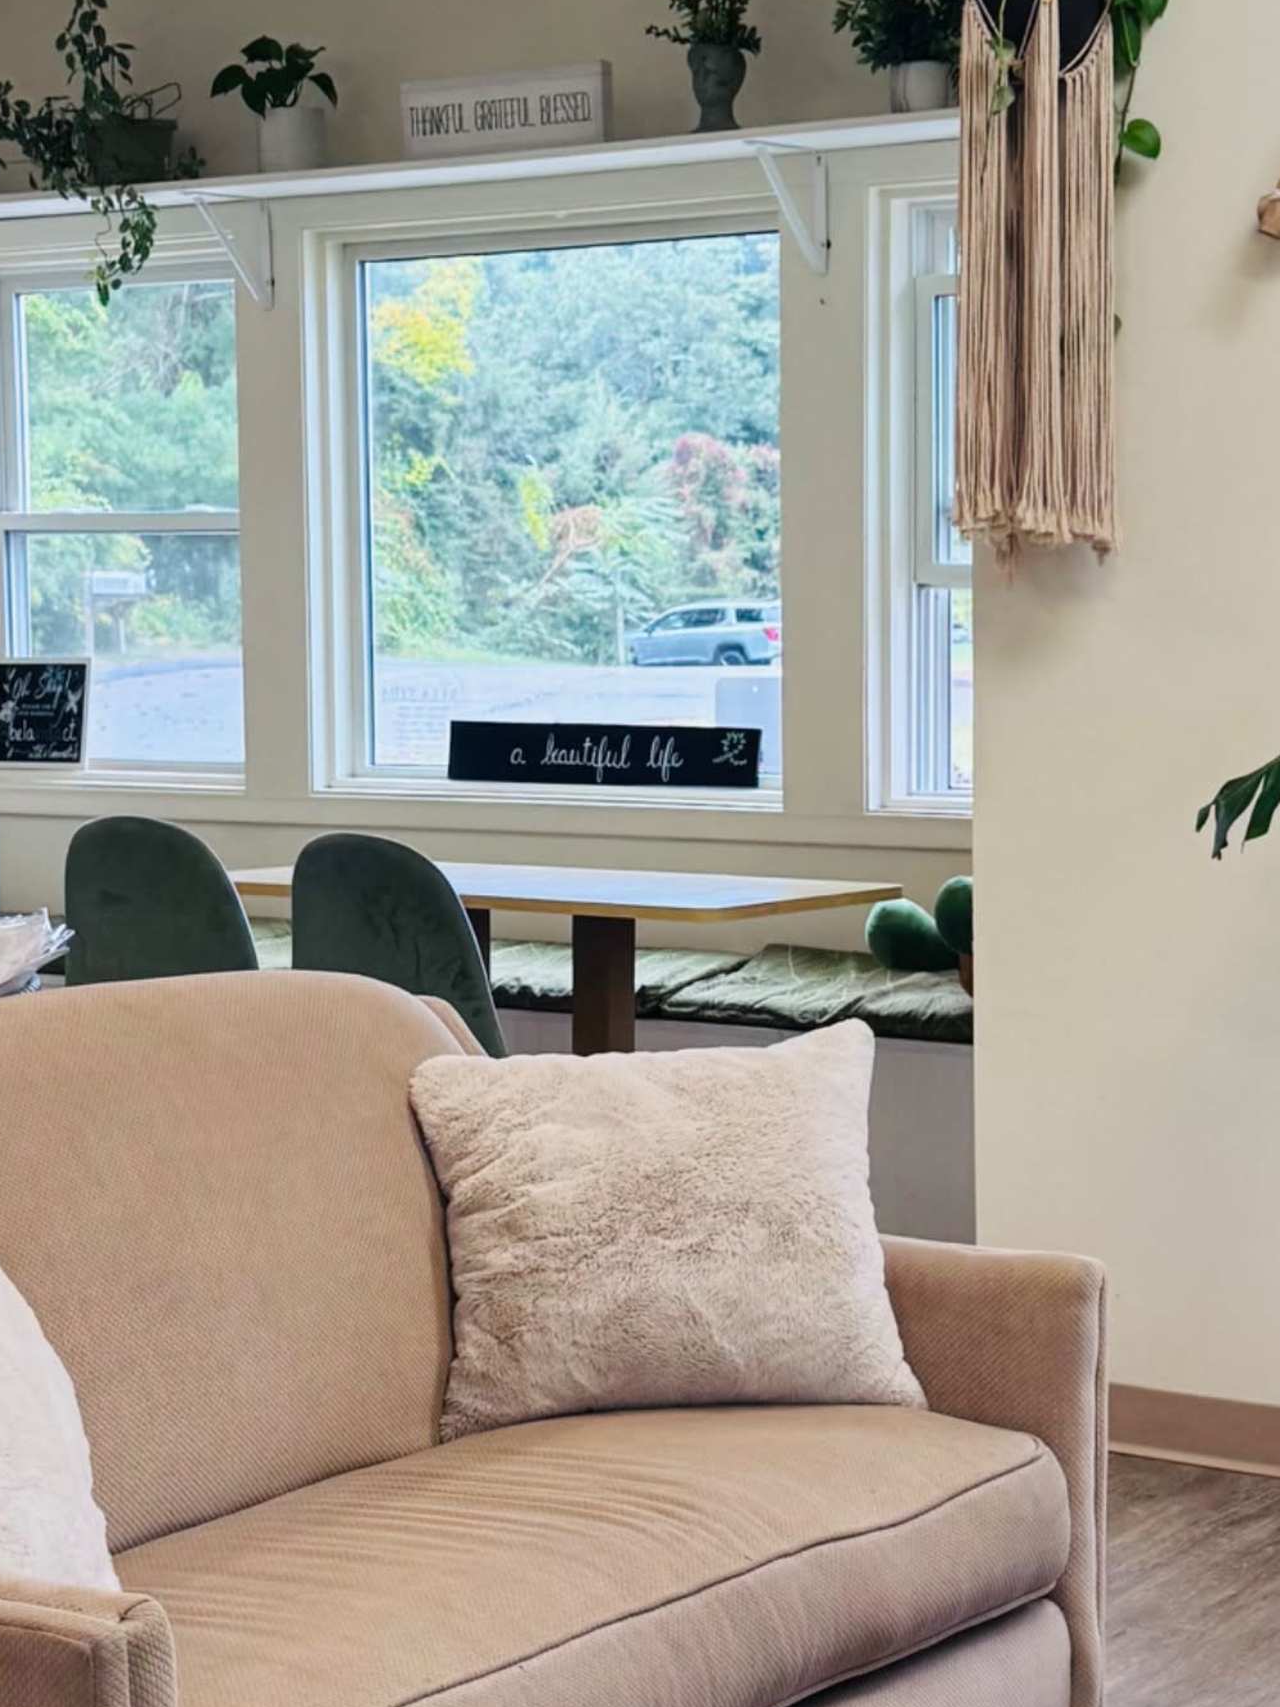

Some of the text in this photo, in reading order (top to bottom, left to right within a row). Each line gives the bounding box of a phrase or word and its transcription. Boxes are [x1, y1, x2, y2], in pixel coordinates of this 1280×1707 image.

[539, 91, 592, 126] BLESSED
[510, 733, 684, 783] a beautiful life
